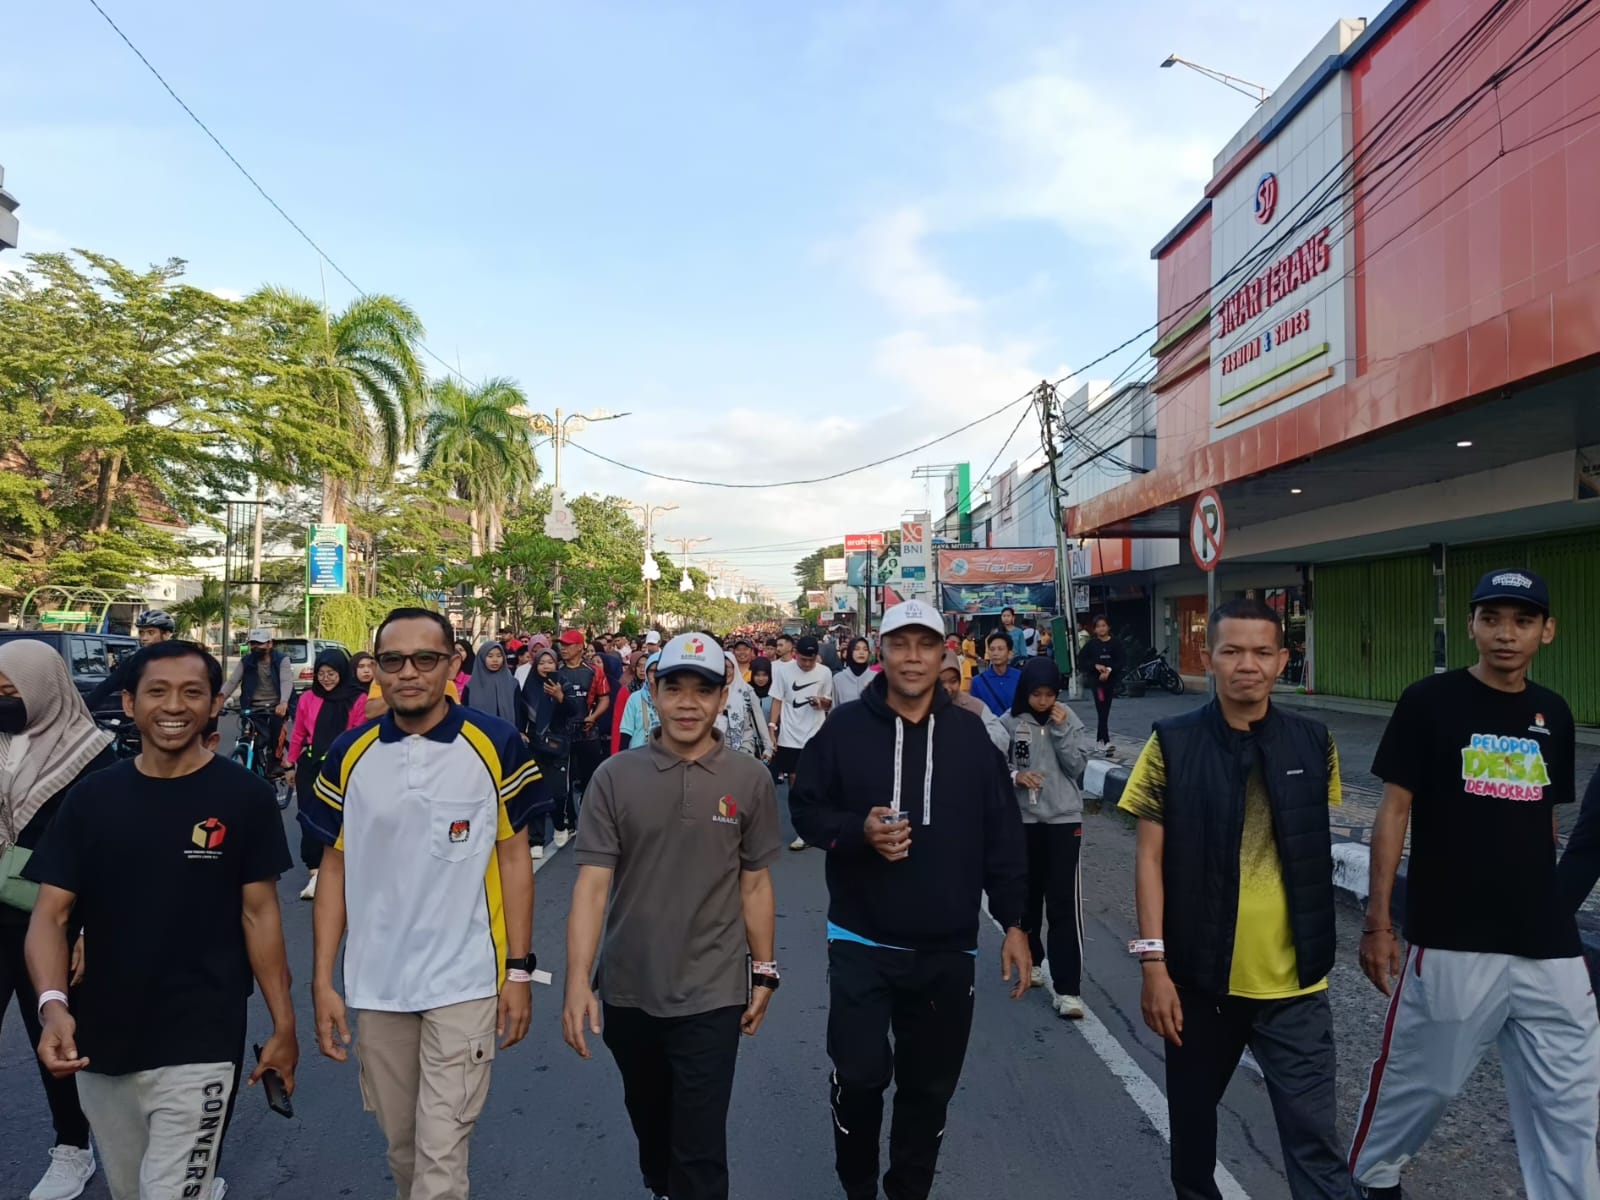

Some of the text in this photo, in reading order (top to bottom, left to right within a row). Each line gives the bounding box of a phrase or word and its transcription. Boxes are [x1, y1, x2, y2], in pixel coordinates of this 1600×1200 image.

[1262, 225, 1331, 307] TERANG
[1222, 308, 1310, 376] FASHION & SHOES
[903, 544, 923, 554] BNI
[1072, 550, 1086, 577] BNI
[1471, 735, 1540, 755] PELOPOR
[1462, 748, 1550, 786] DESA
[1465, 779, 1543, 800] DEMOKRAS
